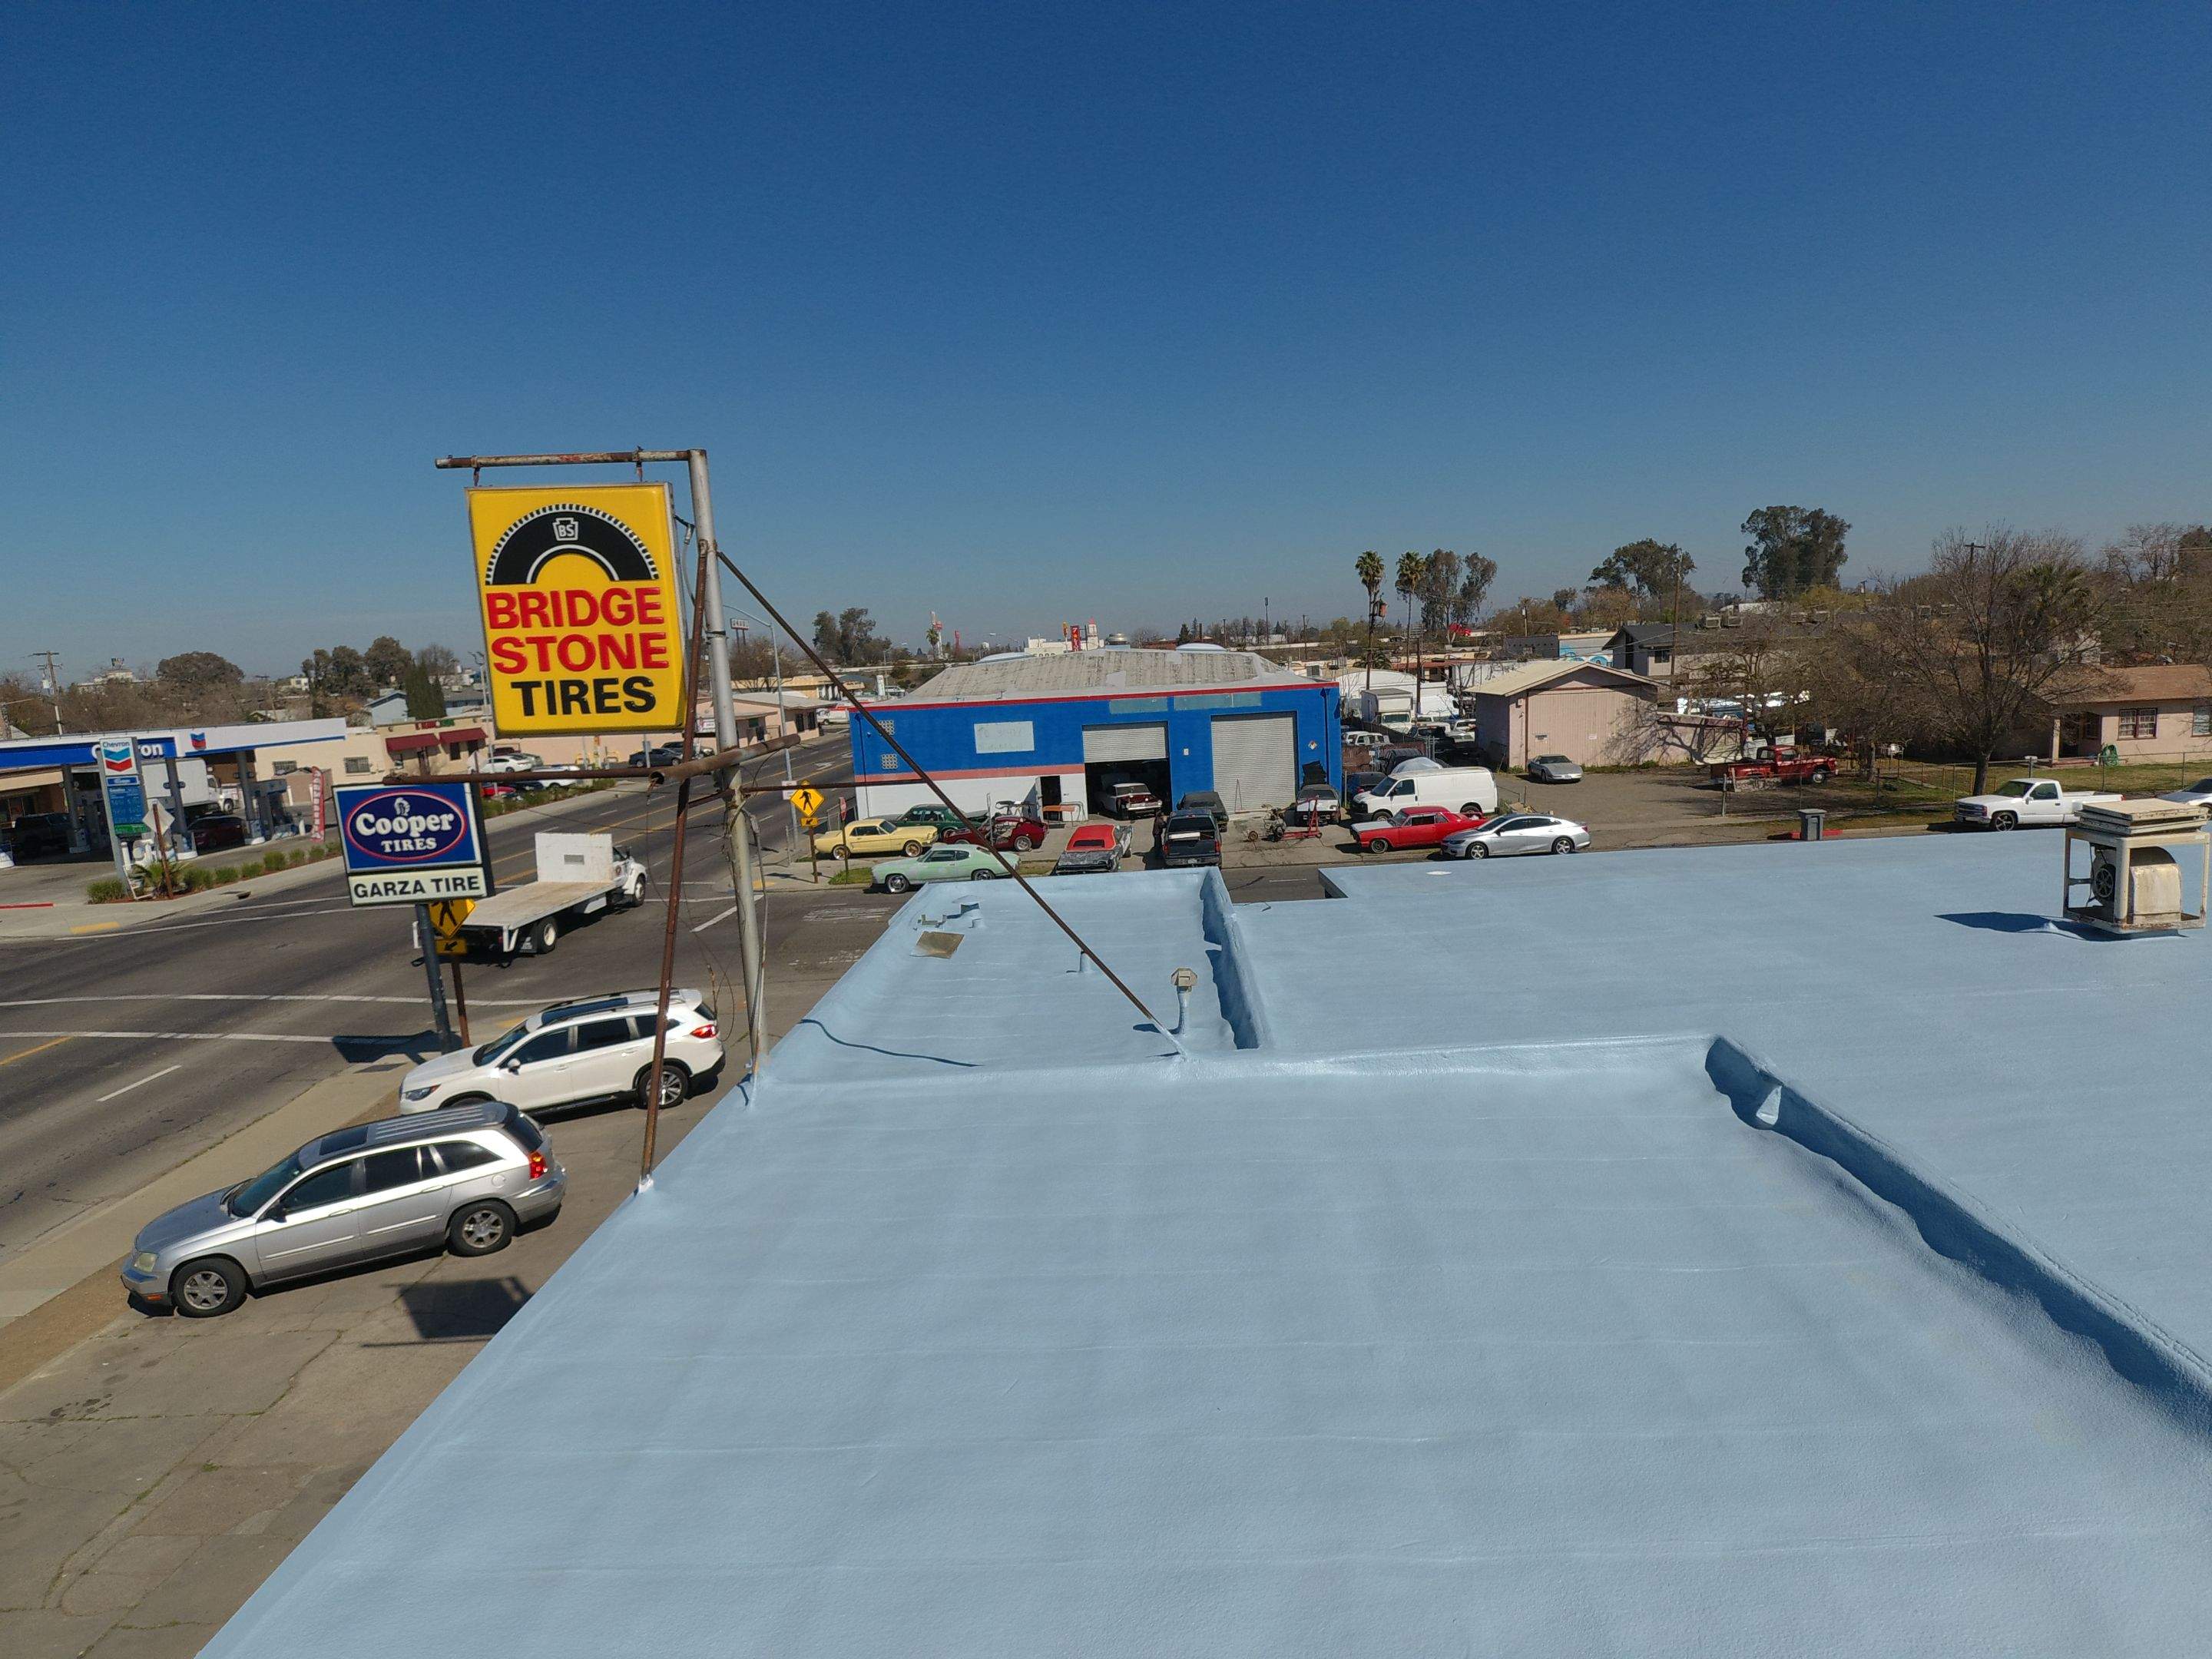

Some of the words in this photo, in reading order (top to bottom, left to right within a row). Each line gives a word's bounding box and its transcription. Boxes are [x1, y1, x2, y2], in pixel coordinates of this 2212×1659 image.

[558, 524, 575, 537] BS
[486, 587, 664, 629] BRIDGE
[491, 632, 669, 674] STONE
[511, 676, 656, 717] TIRES
[356, 813, 455, 837] Cooper
[381, 837, 437, 853] TIRES
[353, 879, 426, 899] GARZA
[431, 876, 480, 893] TIRE
